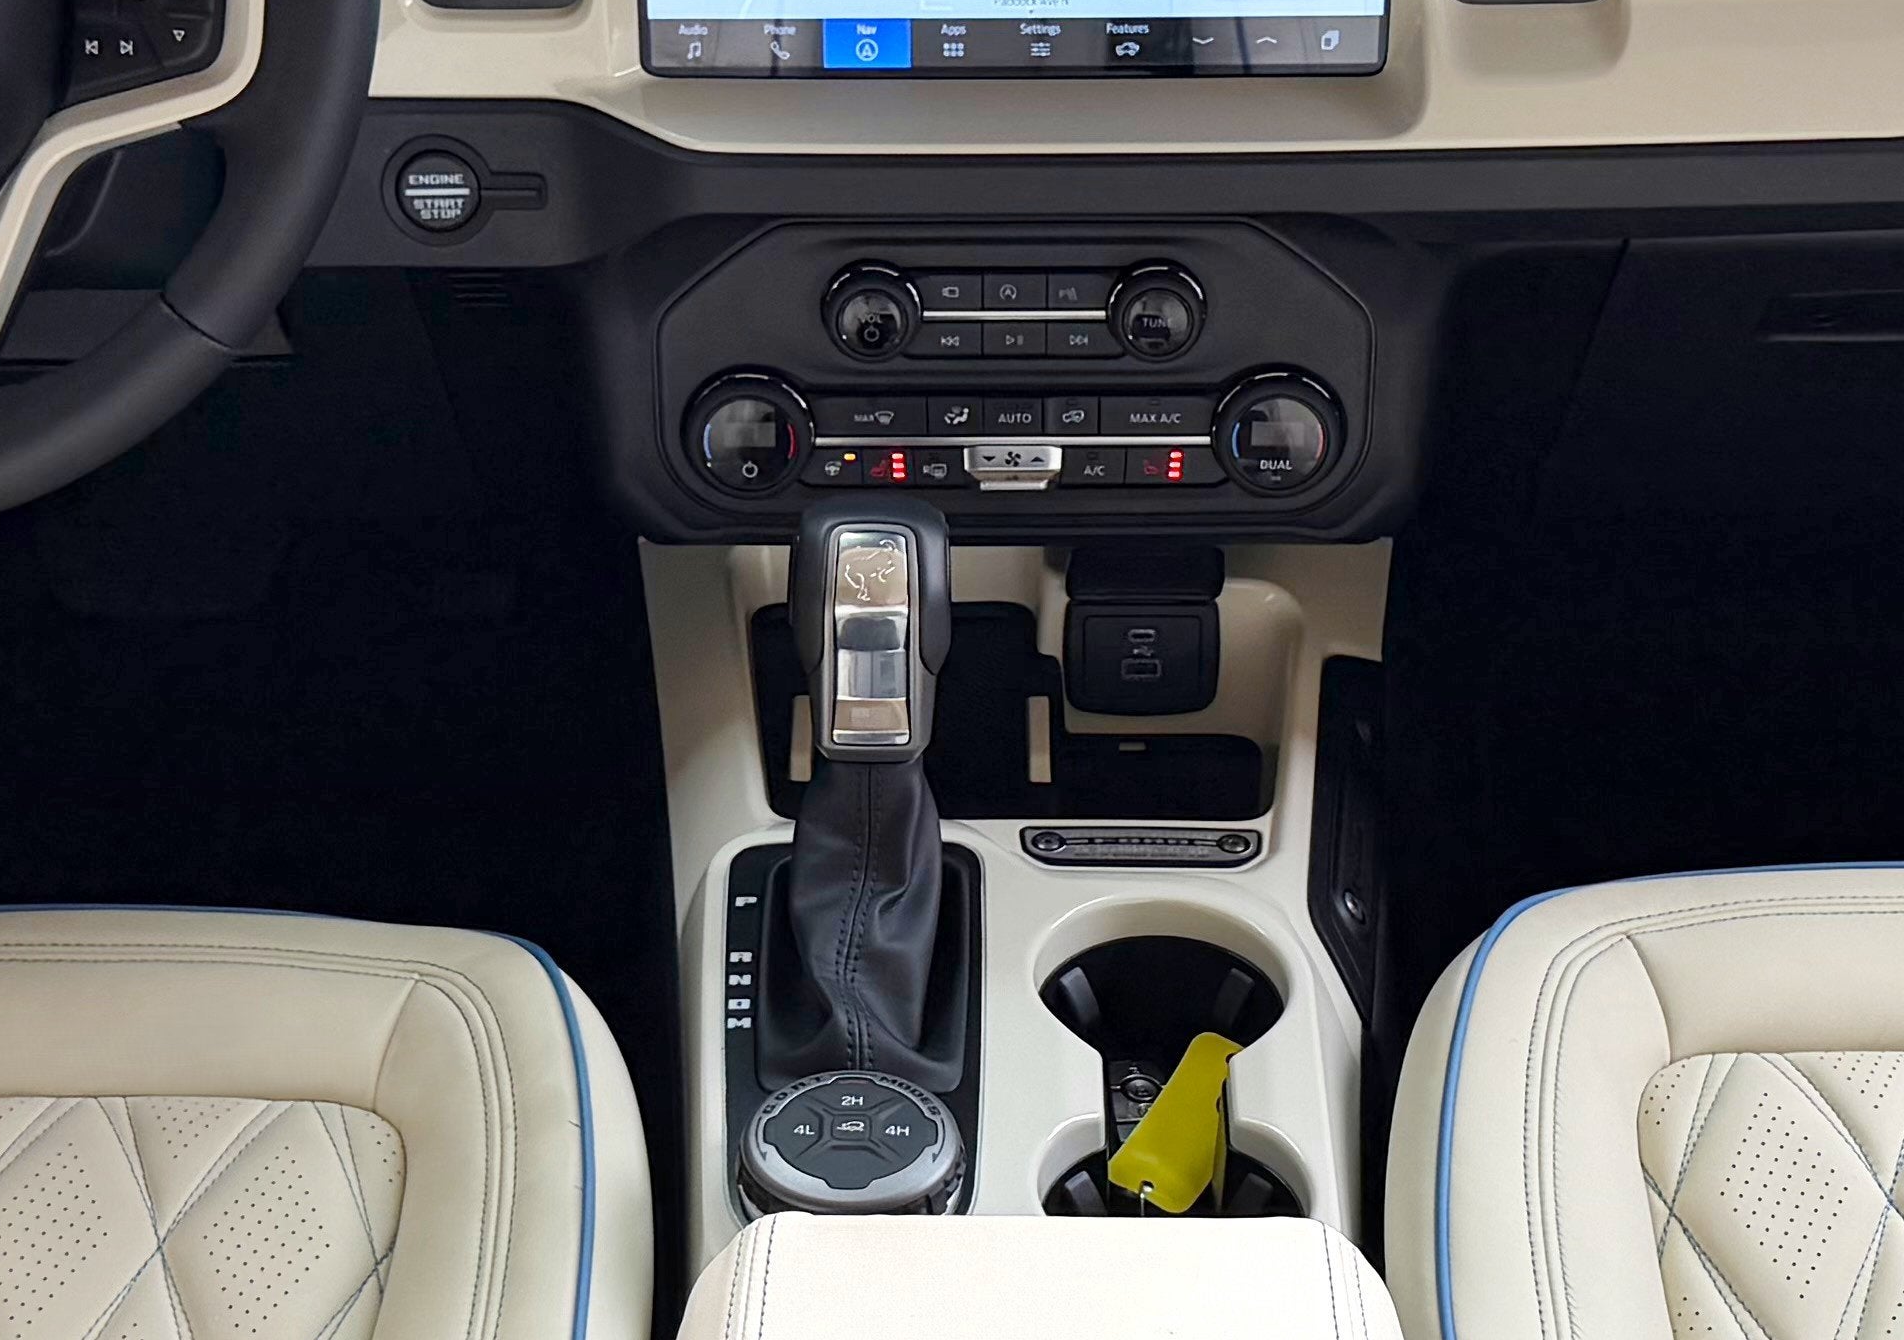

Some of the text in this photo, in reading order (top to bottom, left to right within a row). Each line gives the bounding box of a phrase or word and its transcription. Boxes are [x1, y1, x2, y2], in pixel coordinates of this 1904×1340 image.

[678, 24, 709, 36] Audio
[764, 23, 796, 36] Phone
[856, 23, 877, 35] Nav
[940, 23, 967, 36] Apps
[1020, 23, 1062, 36] Settings
[1106, 23, 1150, 35] Features
[408, 174, 464, 185] ENGINE
[413, 198, 465, 210] START
[420, 209, 462, 220] STOP
[998, 413, 1032, 424] AUTO
[1129, 412, 1182, 425] MAX A/C
[1083, 464, 1105, 477] A/C
[1259, 459, 1293, 471] DUAL
[735, 896, 758, 907] P
[729, 951, 753, 963] R
[728, 974, 752, 986] N
[727, 1017, 752, 1029] M
[841, 1096, 864, 1106] 2H
[879, 1076, 942, 1115] MODES
[793, 1124, 815, 1135] 4L
[885, 1125, 909, 1136] 4H
